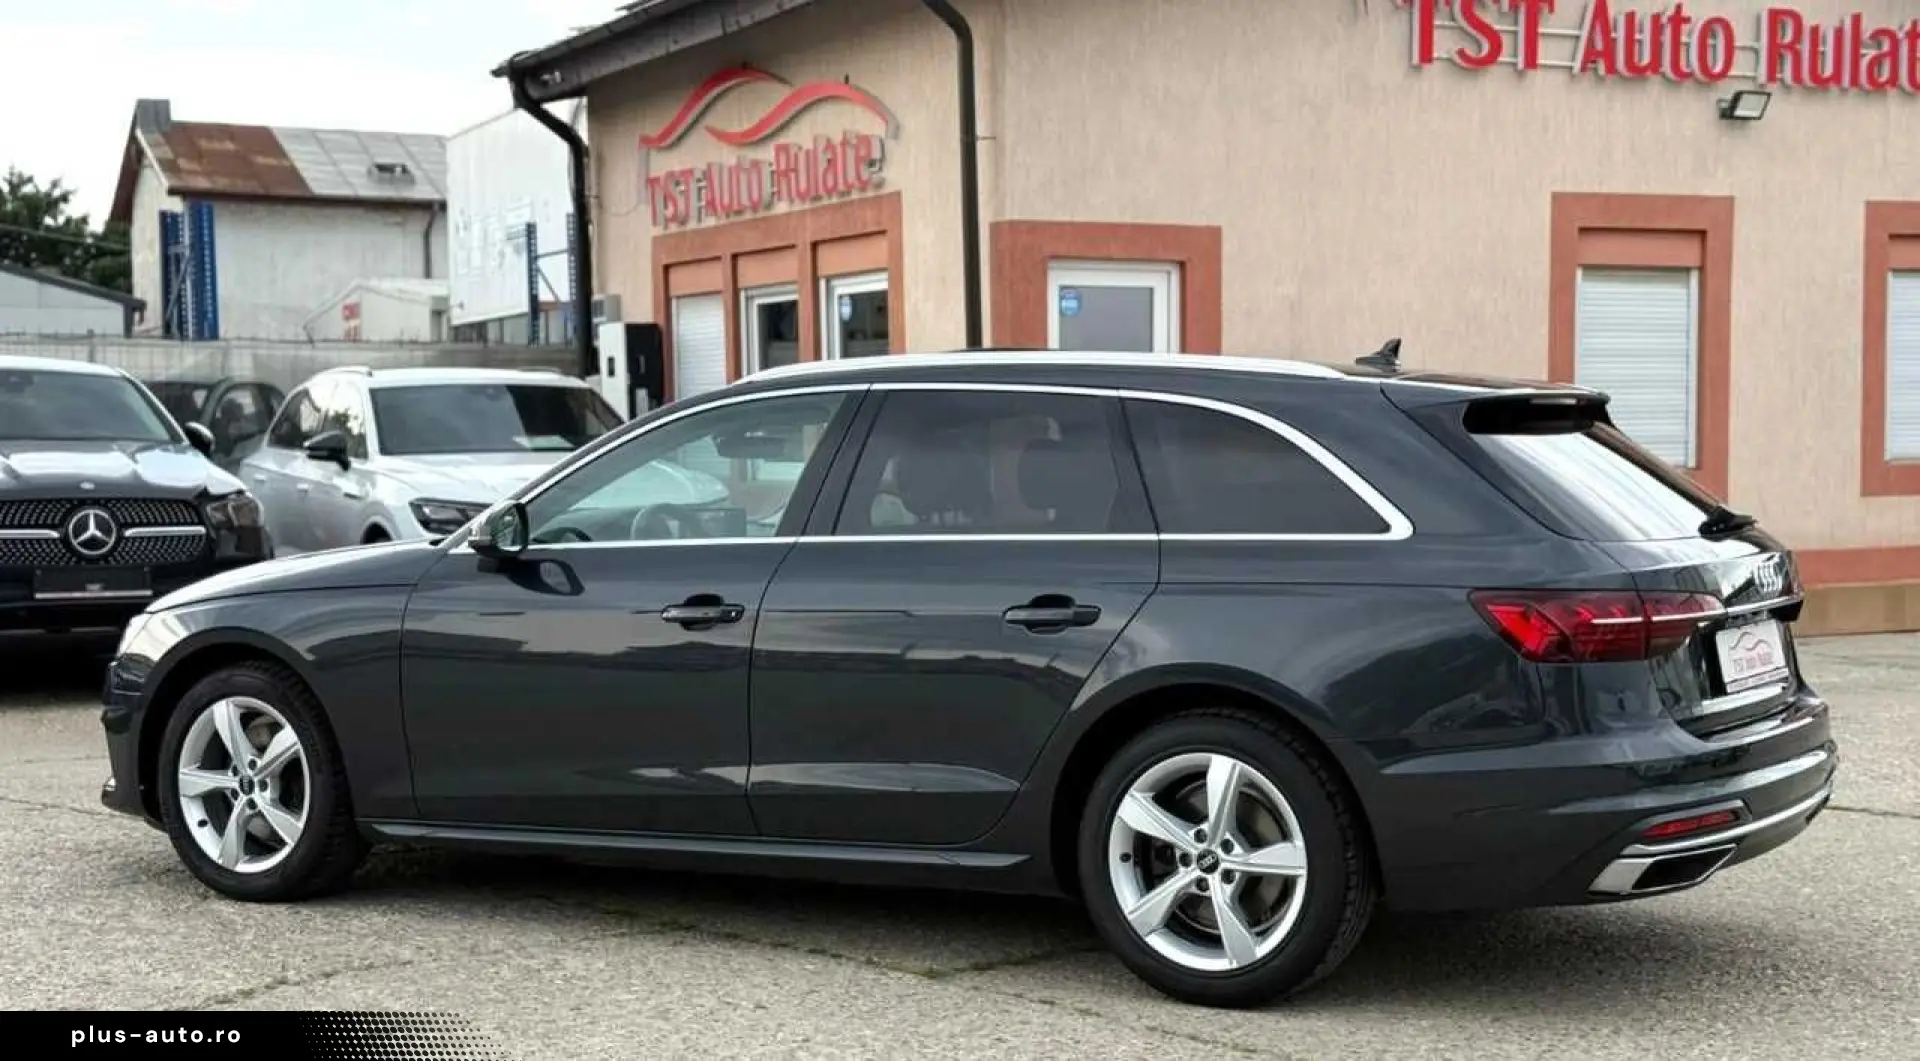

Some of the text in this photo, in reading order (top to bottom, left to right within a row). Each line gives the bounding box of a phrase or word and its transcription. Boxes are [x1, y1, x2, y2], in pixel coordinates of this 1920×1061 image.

[1401, 0, 1553, 70] TST
[1573, 0, 1735, 83] Auto
[648, 132, 881, 228] TST Auto Rulate
